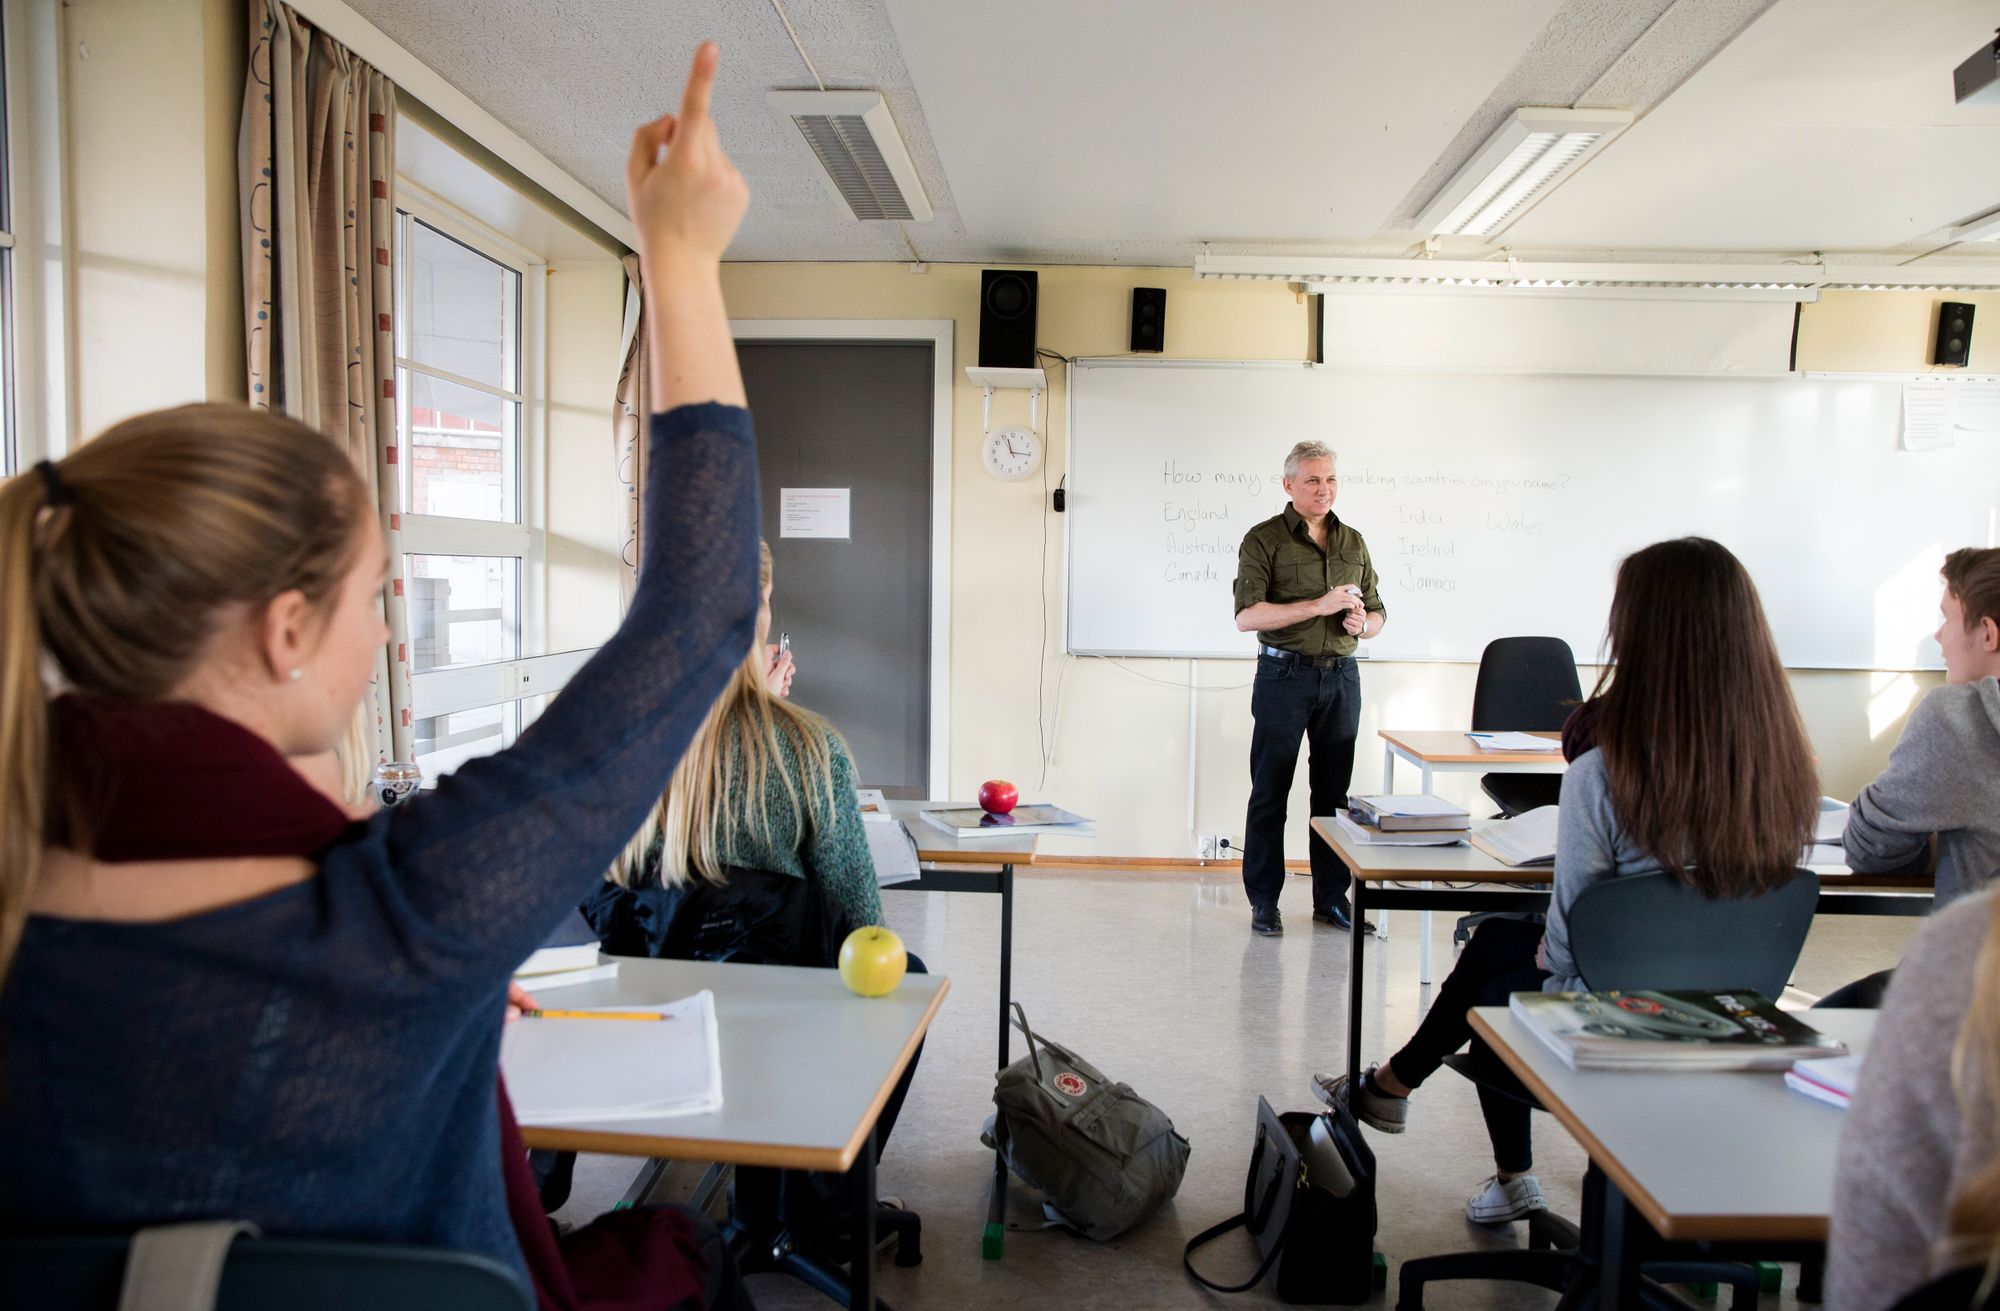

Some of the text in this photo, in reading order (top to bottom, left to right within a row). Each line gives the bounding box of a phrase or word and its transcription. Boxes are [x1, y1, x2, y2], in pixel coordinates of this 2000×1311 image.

[1163, 459, 1202, 485] How
[1214, 471, 1262, 497] many
[1340, 468, 1397, 493] peaking
[1163, 499, 1229, 533] England
[1394, 504, 1444, 526] India
[1486, 511, 1545, 536] Wales
[1167, 531, 1236, 555] Australia
[1397, 536, 1456, 559] Ireland
[1164, 560, 1219, 582] Canada
